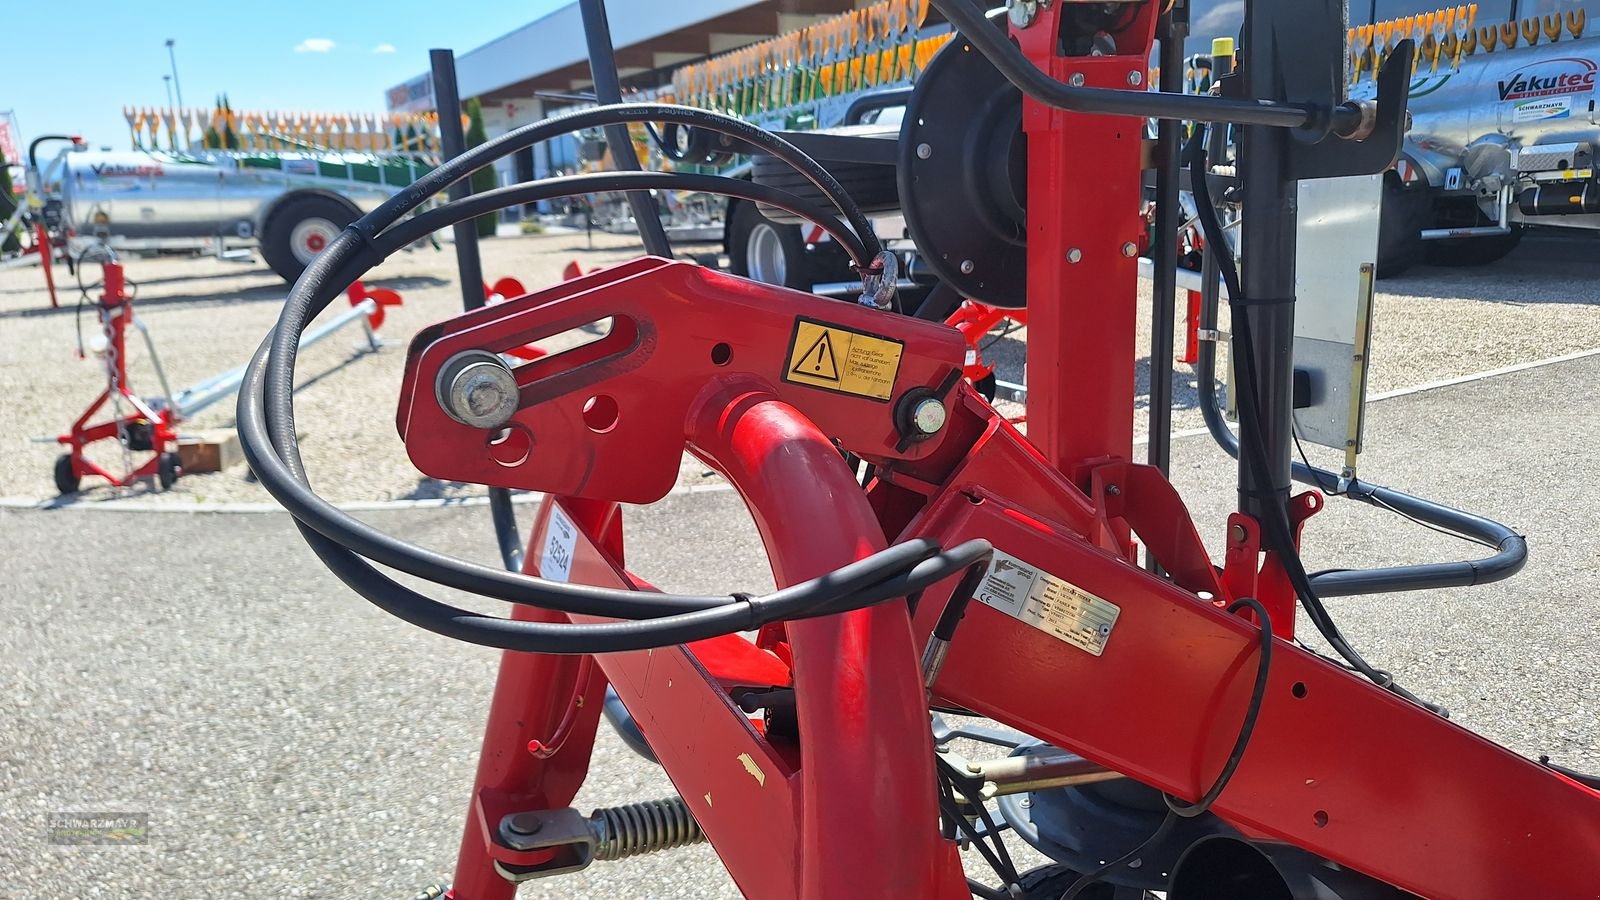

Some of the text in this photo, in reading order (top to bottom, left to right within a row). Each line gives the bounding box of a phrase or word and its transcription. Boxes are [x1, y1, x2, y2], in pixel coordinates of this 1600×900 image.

[1498, 72, 1597, 101] Vakutec
[1519, 102, 1563, 112] SCHWARZMAYR
[550, 535, 569, 573] 52524
